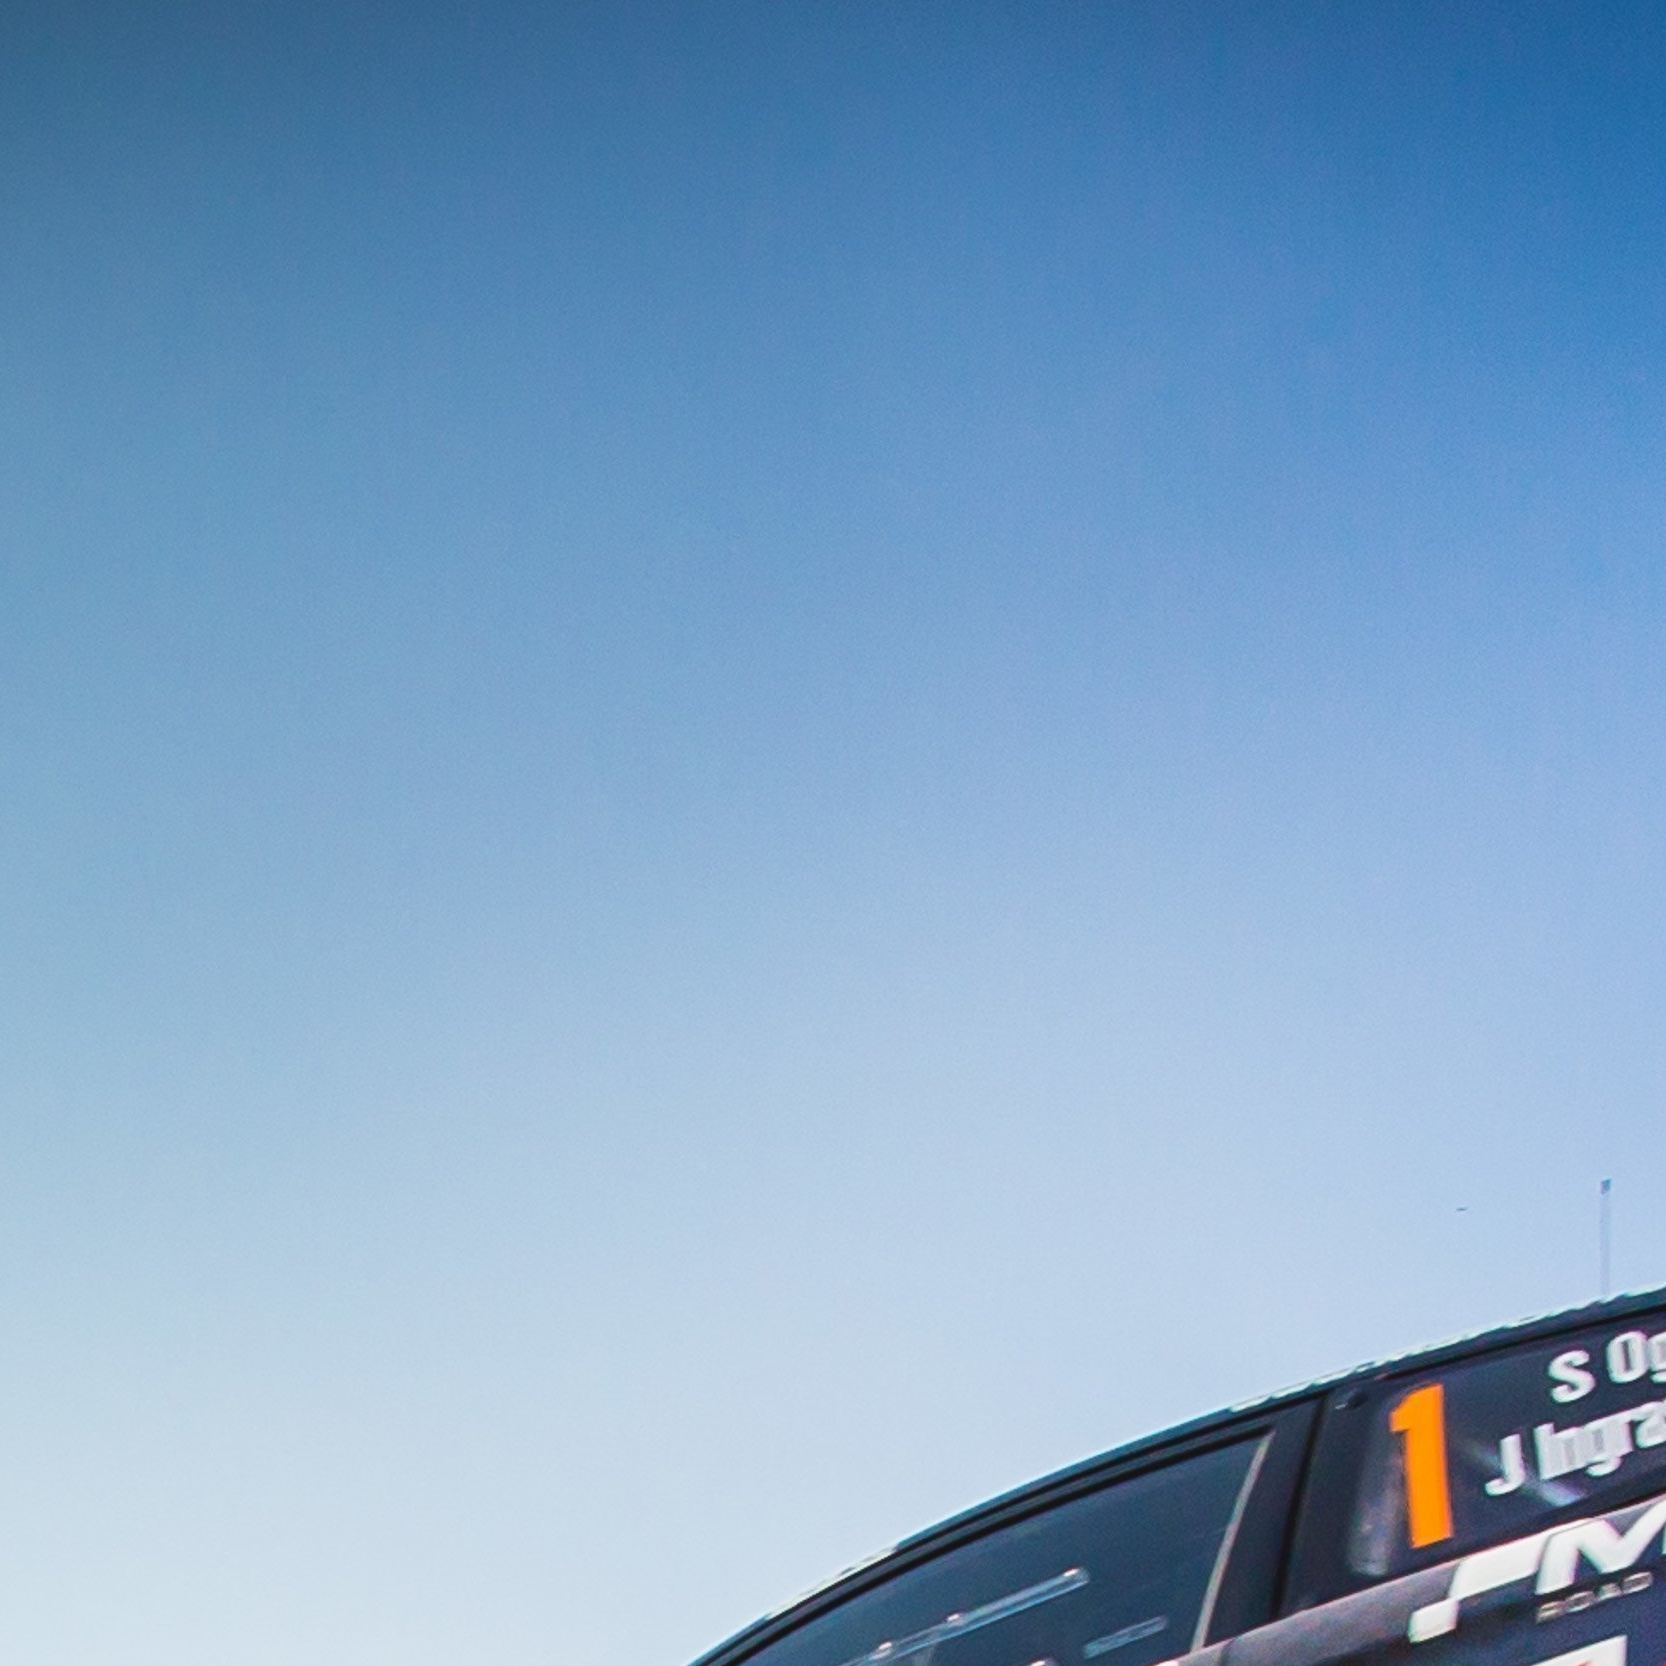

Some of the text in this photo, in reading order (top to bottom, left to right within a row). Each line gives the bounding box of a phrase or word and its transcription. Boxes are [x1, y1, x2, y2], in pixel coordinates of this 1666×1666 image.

[1547, 1350, 1596, 1402] S
[1389, 1384, 1454, 1548] 1
[1485, 1434, 1527, 1497] J
